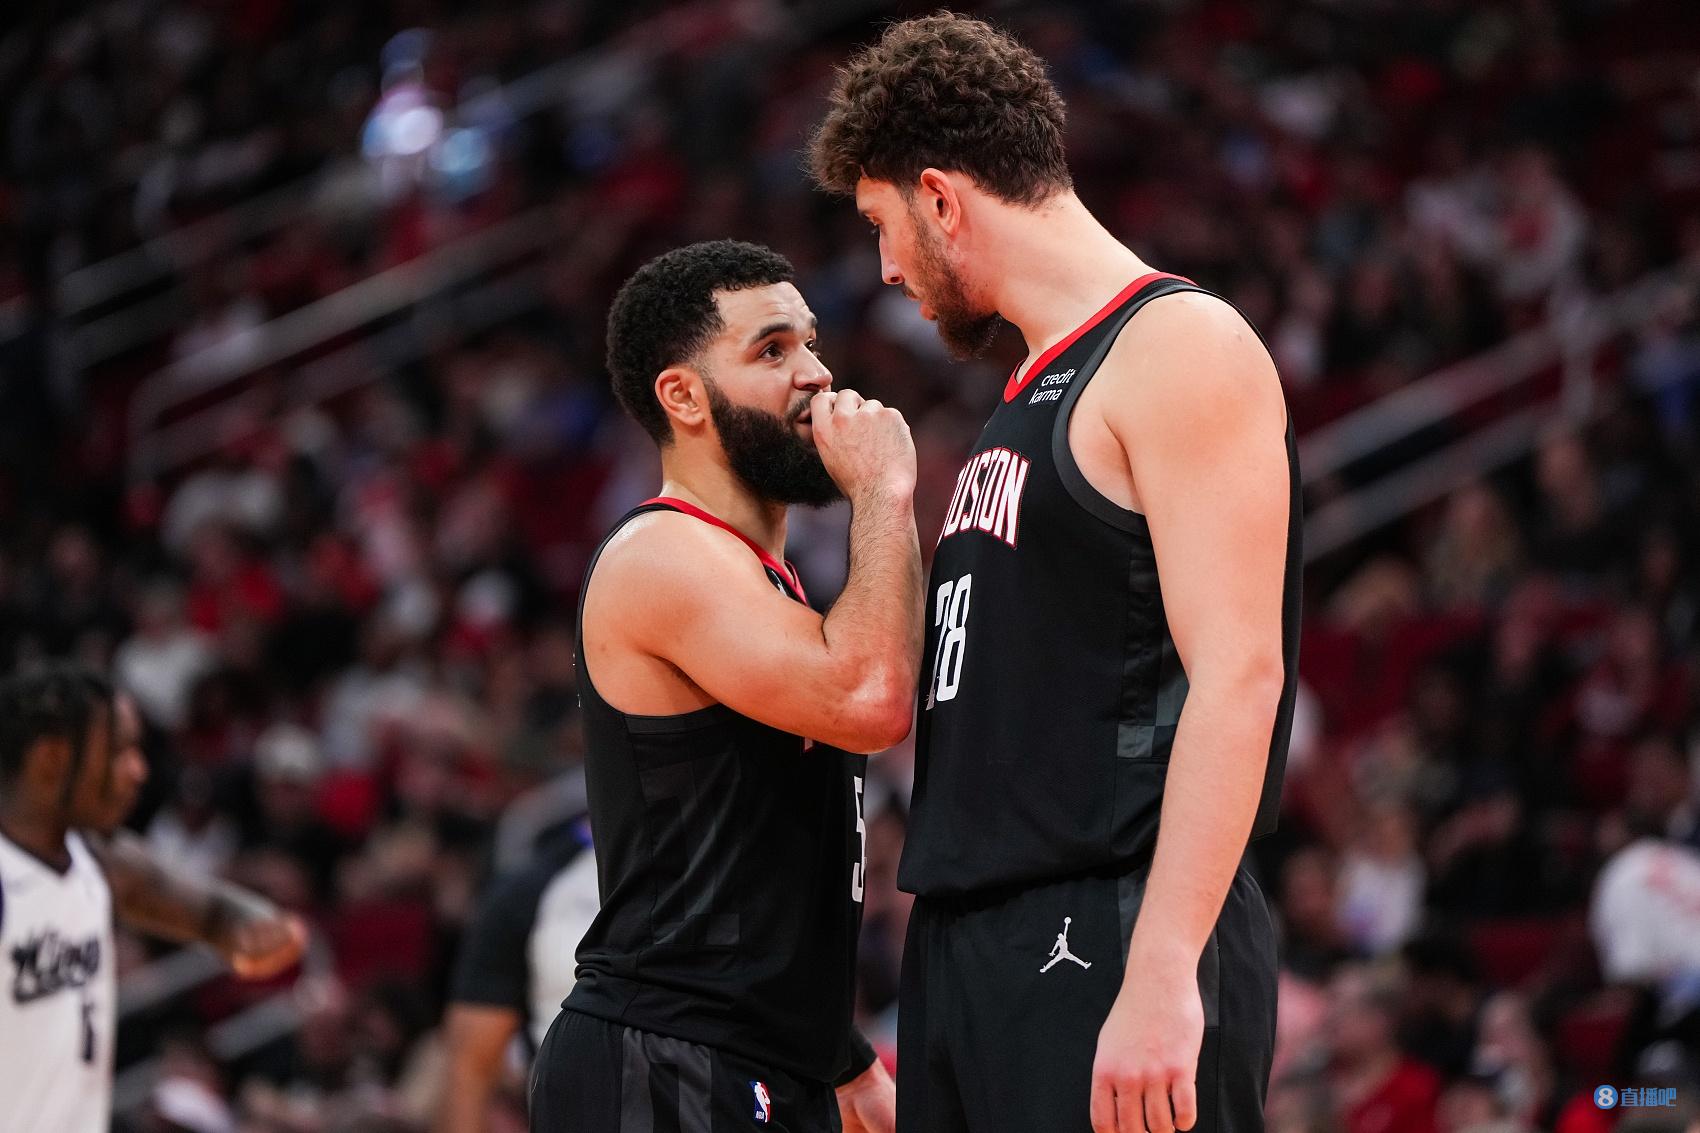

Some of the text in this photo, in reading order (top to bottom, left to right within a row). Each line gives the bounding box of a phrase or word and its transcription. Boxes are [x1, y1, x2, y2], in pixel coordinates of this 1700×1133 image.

[1041, 368, 1076, 387] credit
[1028, 388, 1063, 405] karma
[852, 776, 866, 903] 5
